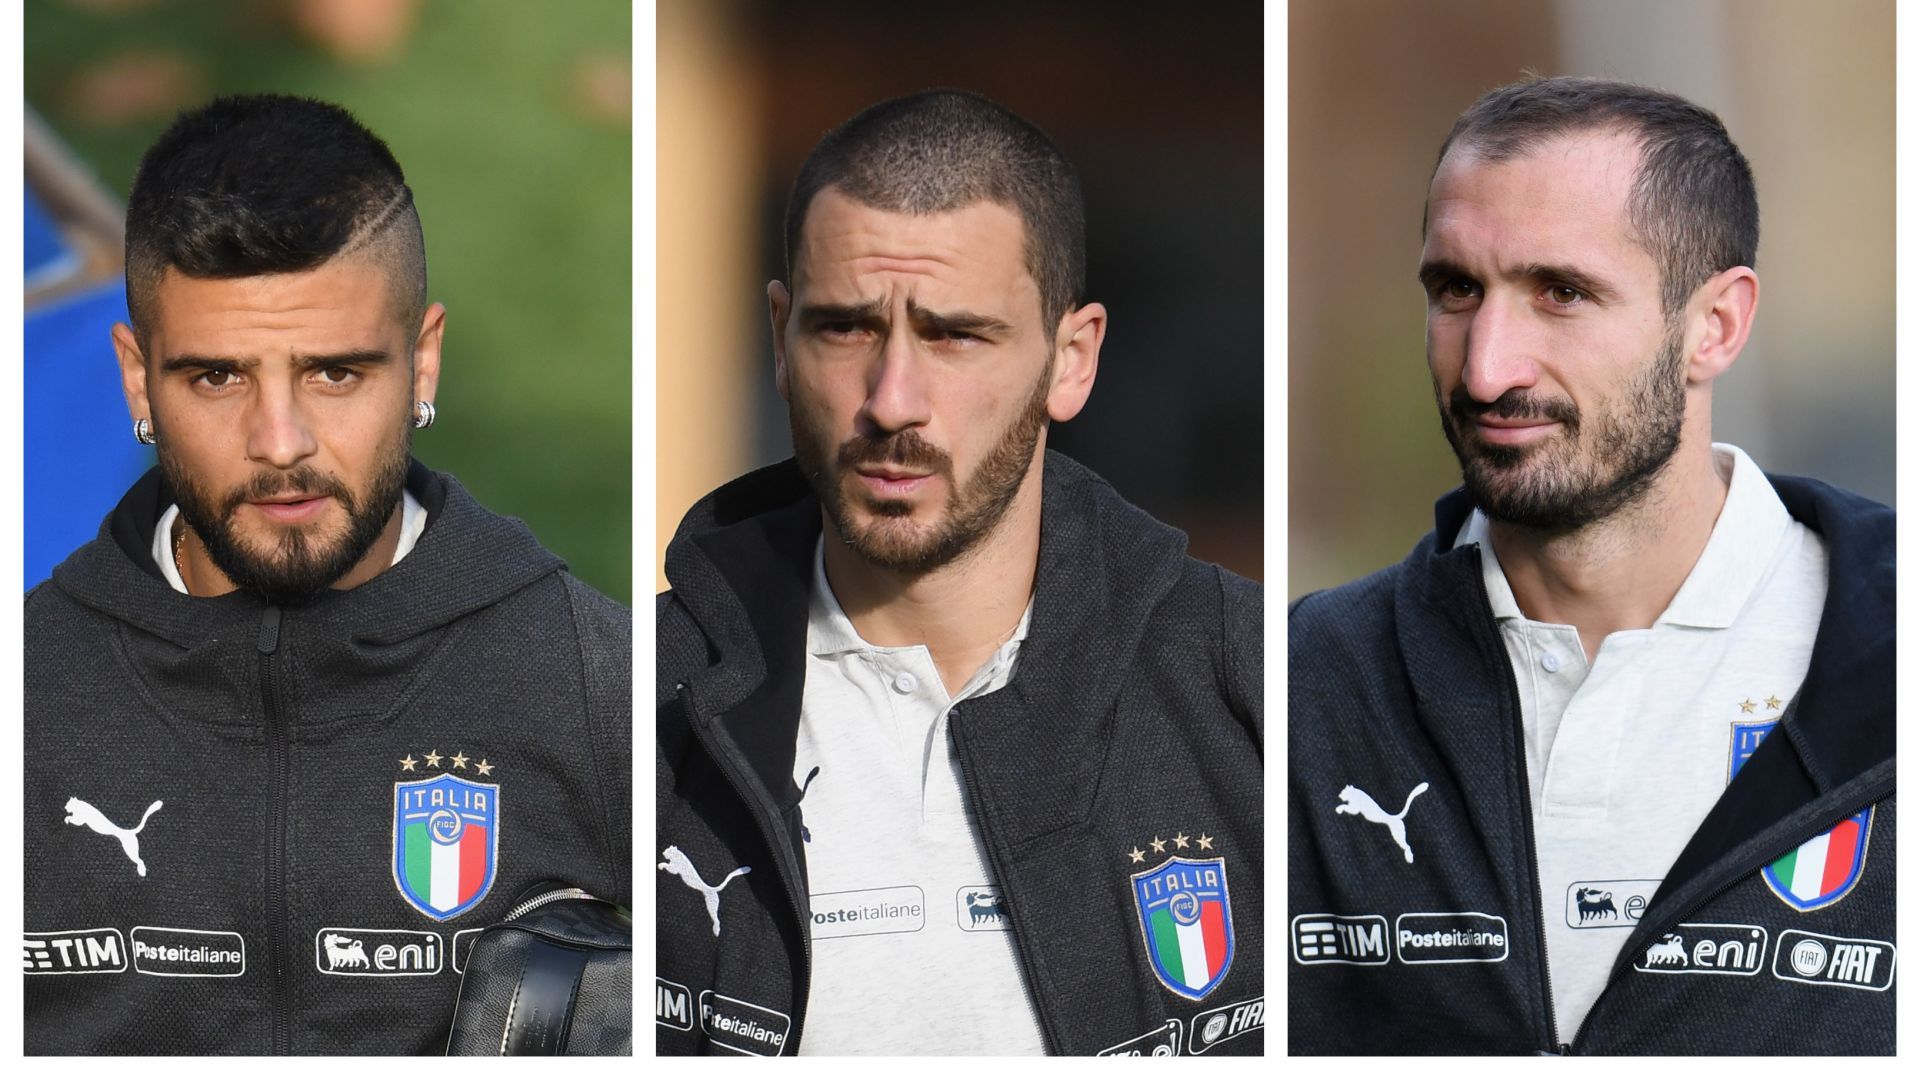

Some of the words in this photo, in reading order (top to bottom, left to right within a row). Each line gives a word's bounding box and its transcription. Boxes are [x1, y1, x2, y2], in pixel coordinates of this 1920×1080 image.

[405, 789, 486, 812] ITALIA
[1143, 869, 1218, 900] ITALIA
[51, 936, 121, 967] TIM
[374, 935, 435, 970] eni
[1337, 923, 1384, 957] TIM
[1693, 929, 1761, 969] eni
[1800, 950, 1819, 966] FIAT
[1827, 944, 1882, 983] FIAT
[656, 986, 687, 1023] IM
[1228, 1002, 1264, 1035] FIA
[703, 1004, 783, 1046] Pteitaliane
